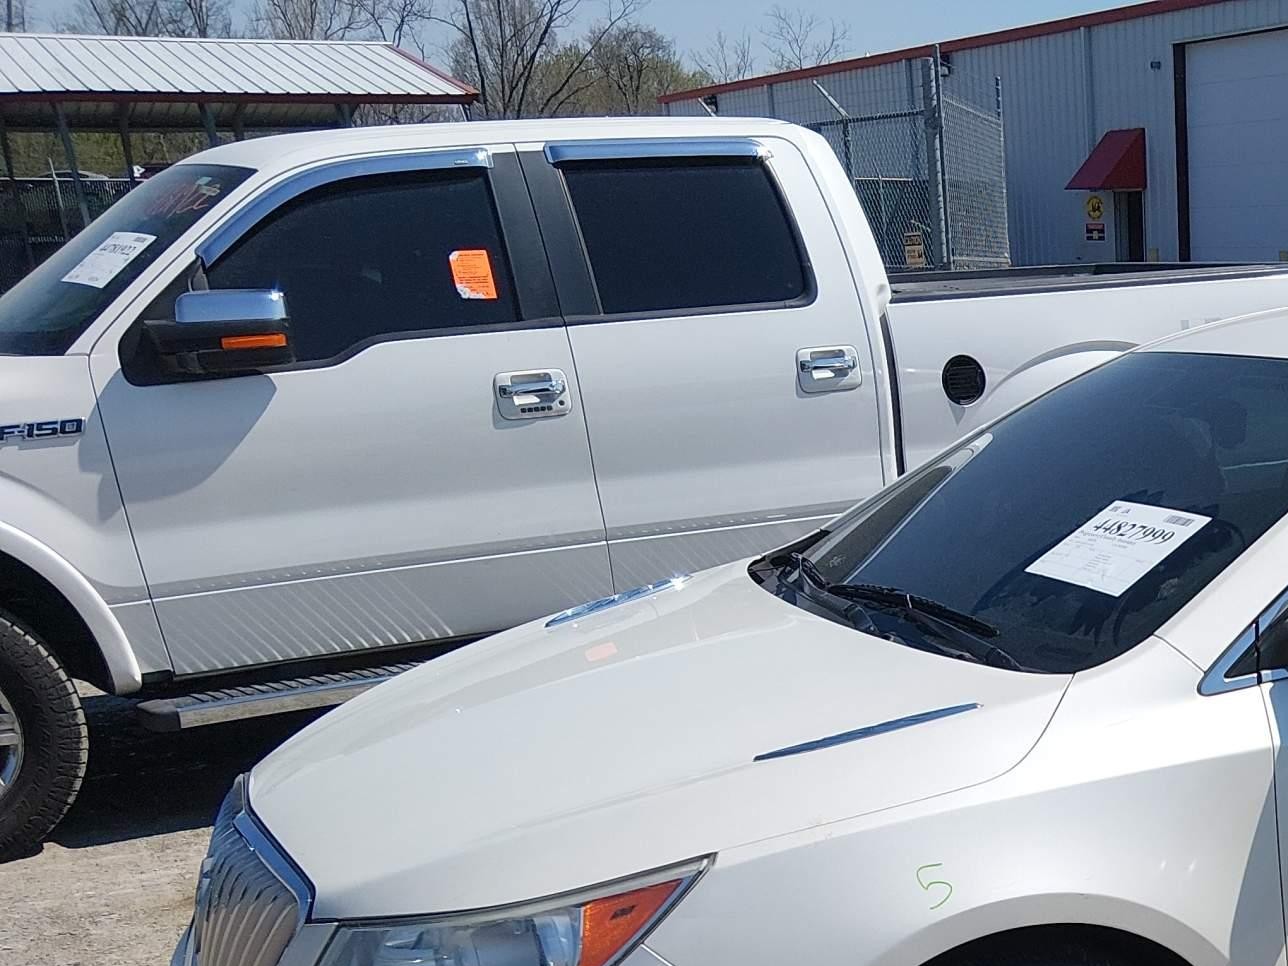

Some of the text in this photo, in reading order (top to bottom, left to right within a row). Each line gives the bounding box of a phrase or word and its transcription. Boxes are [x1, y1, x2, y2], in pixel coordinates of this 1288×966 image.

[0, 418, 83, 441] F-150
[1093, 518, 1175, 545] 44827999
[916, 862, 953, 910] 5
